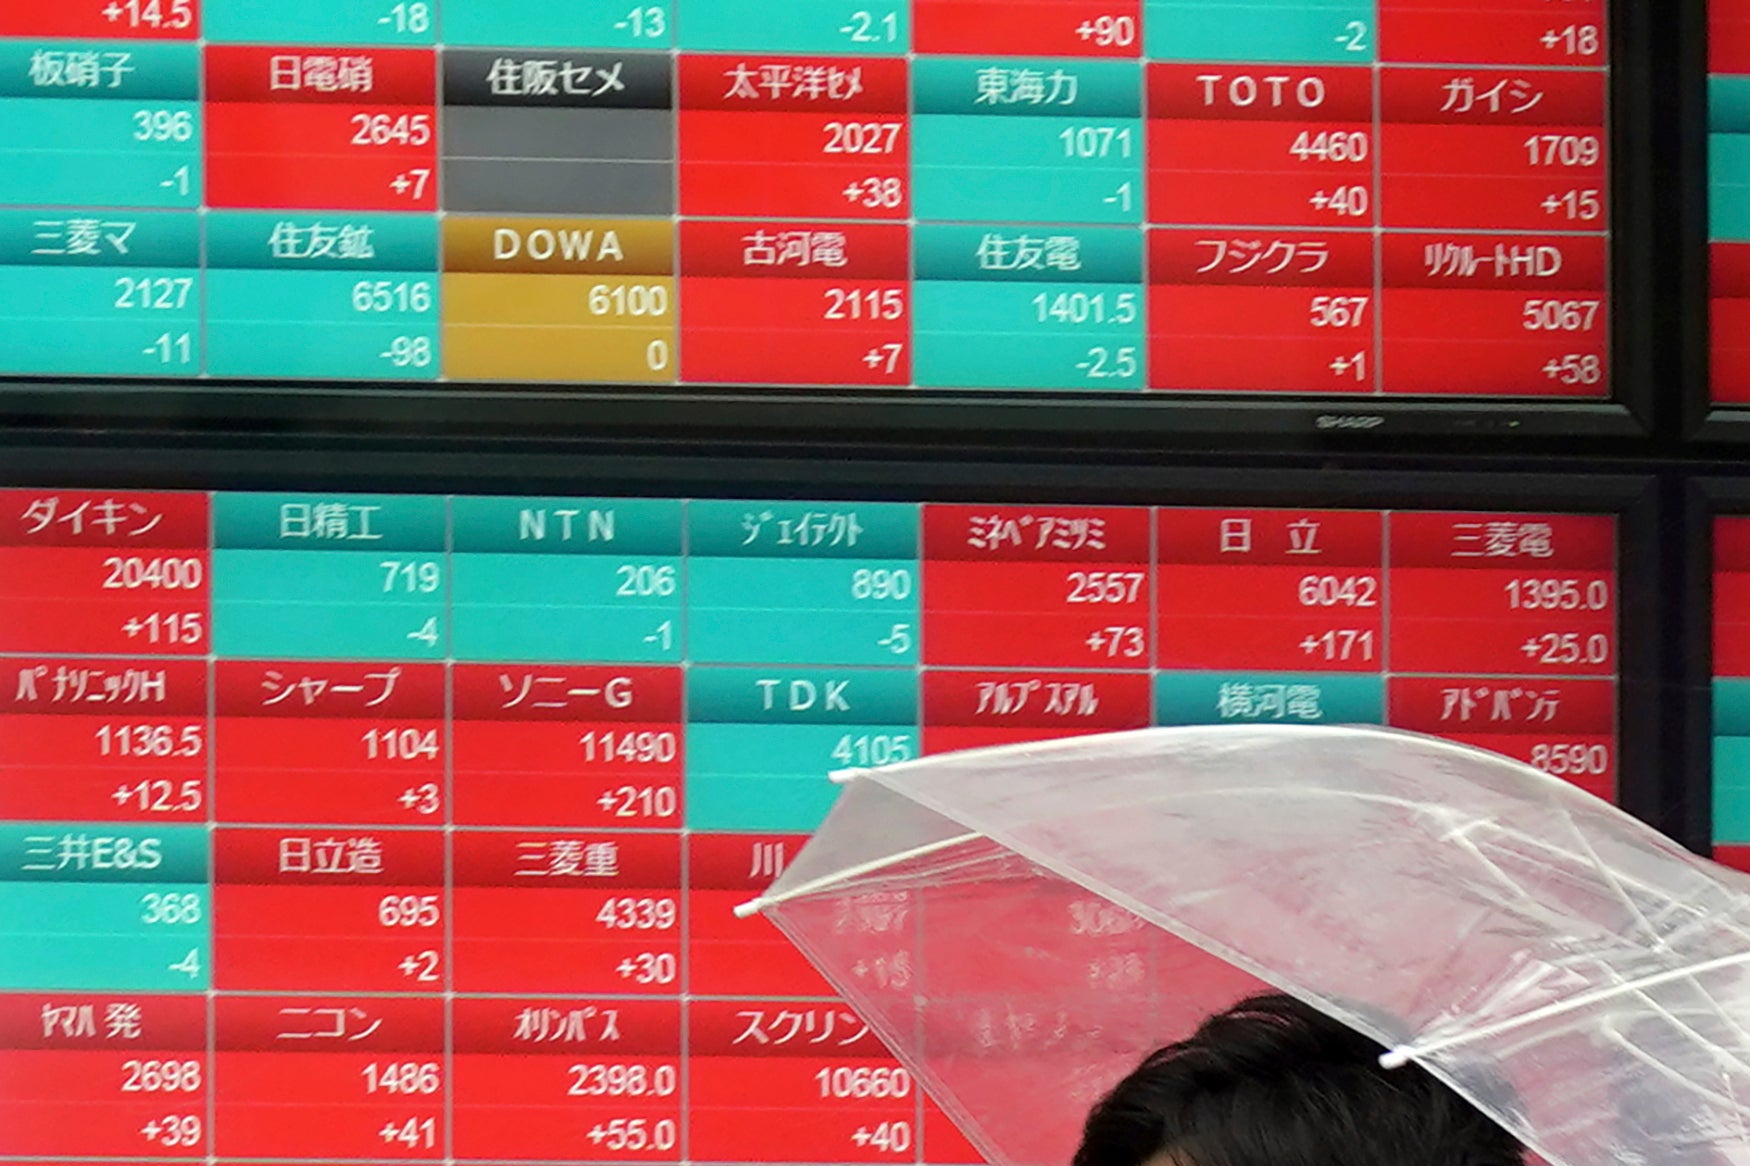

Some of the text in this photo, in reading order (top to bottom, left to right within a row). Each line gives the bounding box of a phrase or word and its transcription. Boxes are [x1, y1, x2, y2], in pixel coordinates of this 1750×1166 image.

[100, 0, 193, 30] +14.5
[27, 50, 132, 90] 板硝子
[269, 54, 374, 94] 日電硝
[485, 57, 626, 98] 住阪セメ
[974, 65, 1078, 107] 東海力
[1439, 76, 1544, 115] ガイシ
[132, 108, 194, 143] 396
[1058, 125, 1132, 159] 1071
[1523, 134, 1600, 167] 1709
[30, 217, 137, 256] 三菱マ
[741, 228, 849, 268] 古河電
[974, 232, 1083, 272] 住友電
[1196, 238, 1329, 275] フジクラ
[351, 279, 432, 314] 6516
[823, 287, 904, 321] 2115
[1309, 295, 1370, 328] 567
[141, 331, 192, 365] -11
[20, 496, 163, 537] ダイキン
[279, 501, 384, 541] 日精工
[1450, 520, 1555, 559] 三菱電
[102, 555, 203, 590] 20400
[615, 563, 677, 597] 206
[1065, 570, 1146, 604] 2557
[1504, 577, 1608, 611] 1395.0
[261, 665, 402, 707] シャープ
[498, 673, 633, 709] ソニーG
[1215, 681, 1324, 721] 横河電
[361, 727, 441, 761] 1104
[25, 833, 163, 870] 三井E&S
[278, 836, 384, 875] 日立造
[514, 838, 619, 878] 三菱重
[141, 891, 203, 925] 368
[594, 896, 677, 930] 4339
[276, 1006, 383, 1042] ニコン
[361, 1061, 441, 1096] 1486
[140, 1114, 202, 1148] +39
